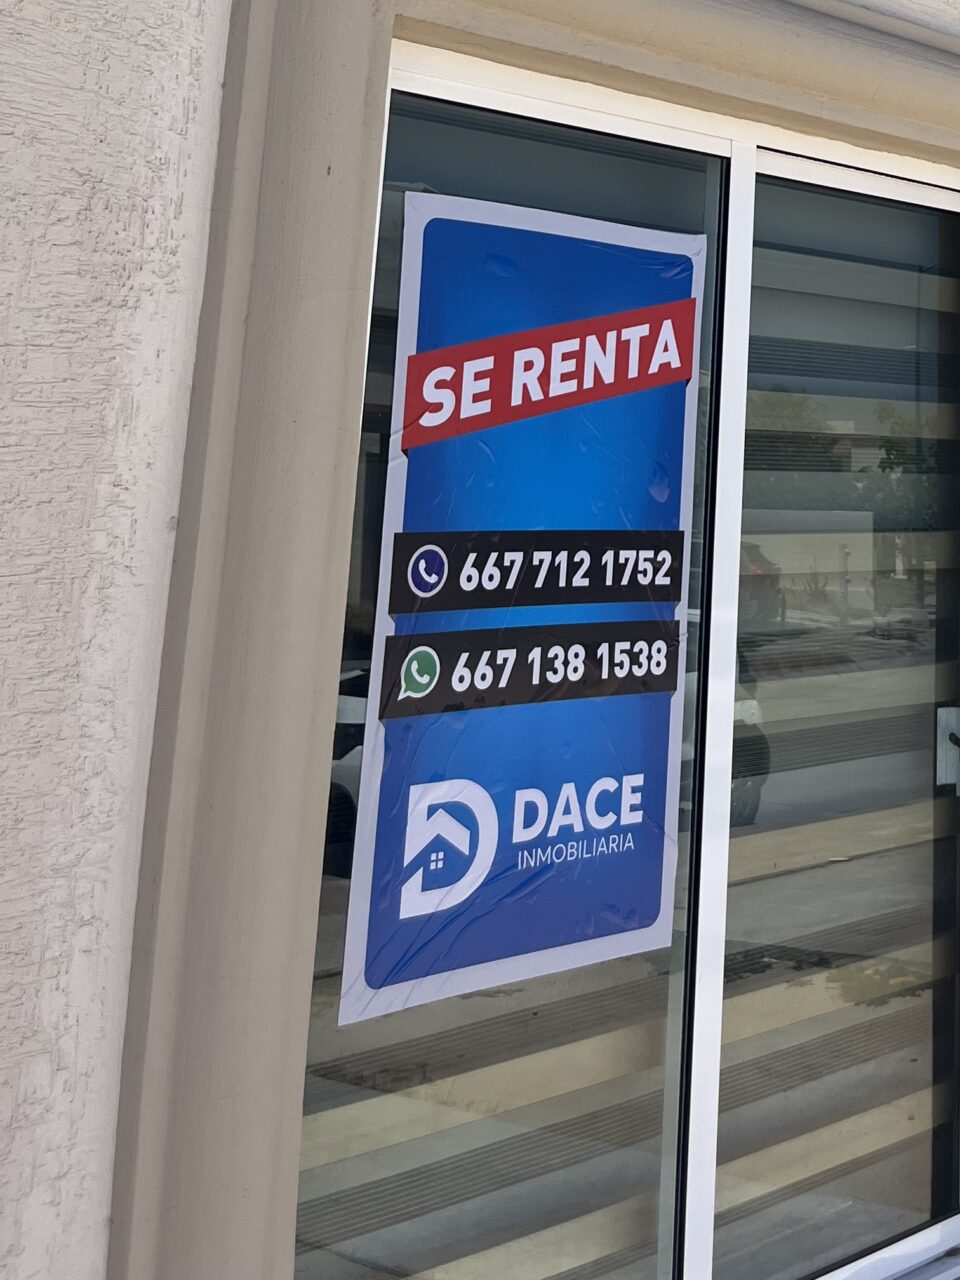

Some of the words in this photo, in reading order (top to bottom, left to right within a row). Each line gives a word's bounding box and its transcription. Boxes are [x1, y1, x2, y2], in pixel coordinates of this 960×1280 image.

[418, 355, 495, 427] SE
[510, 318, 682, 407] RENTA
[459, 550, 524, 592] 667
[532, 549, 591, 588] 712
[601, 549, 672, 587] 1752
[451, 648, 517, 692] 667
[527, 643, 586, 685] 138
[596, 639, 668, 680] 1538
[512, 773, 645, 844] DACE
[517, 832, 635, 870] INMOBILIARIA
